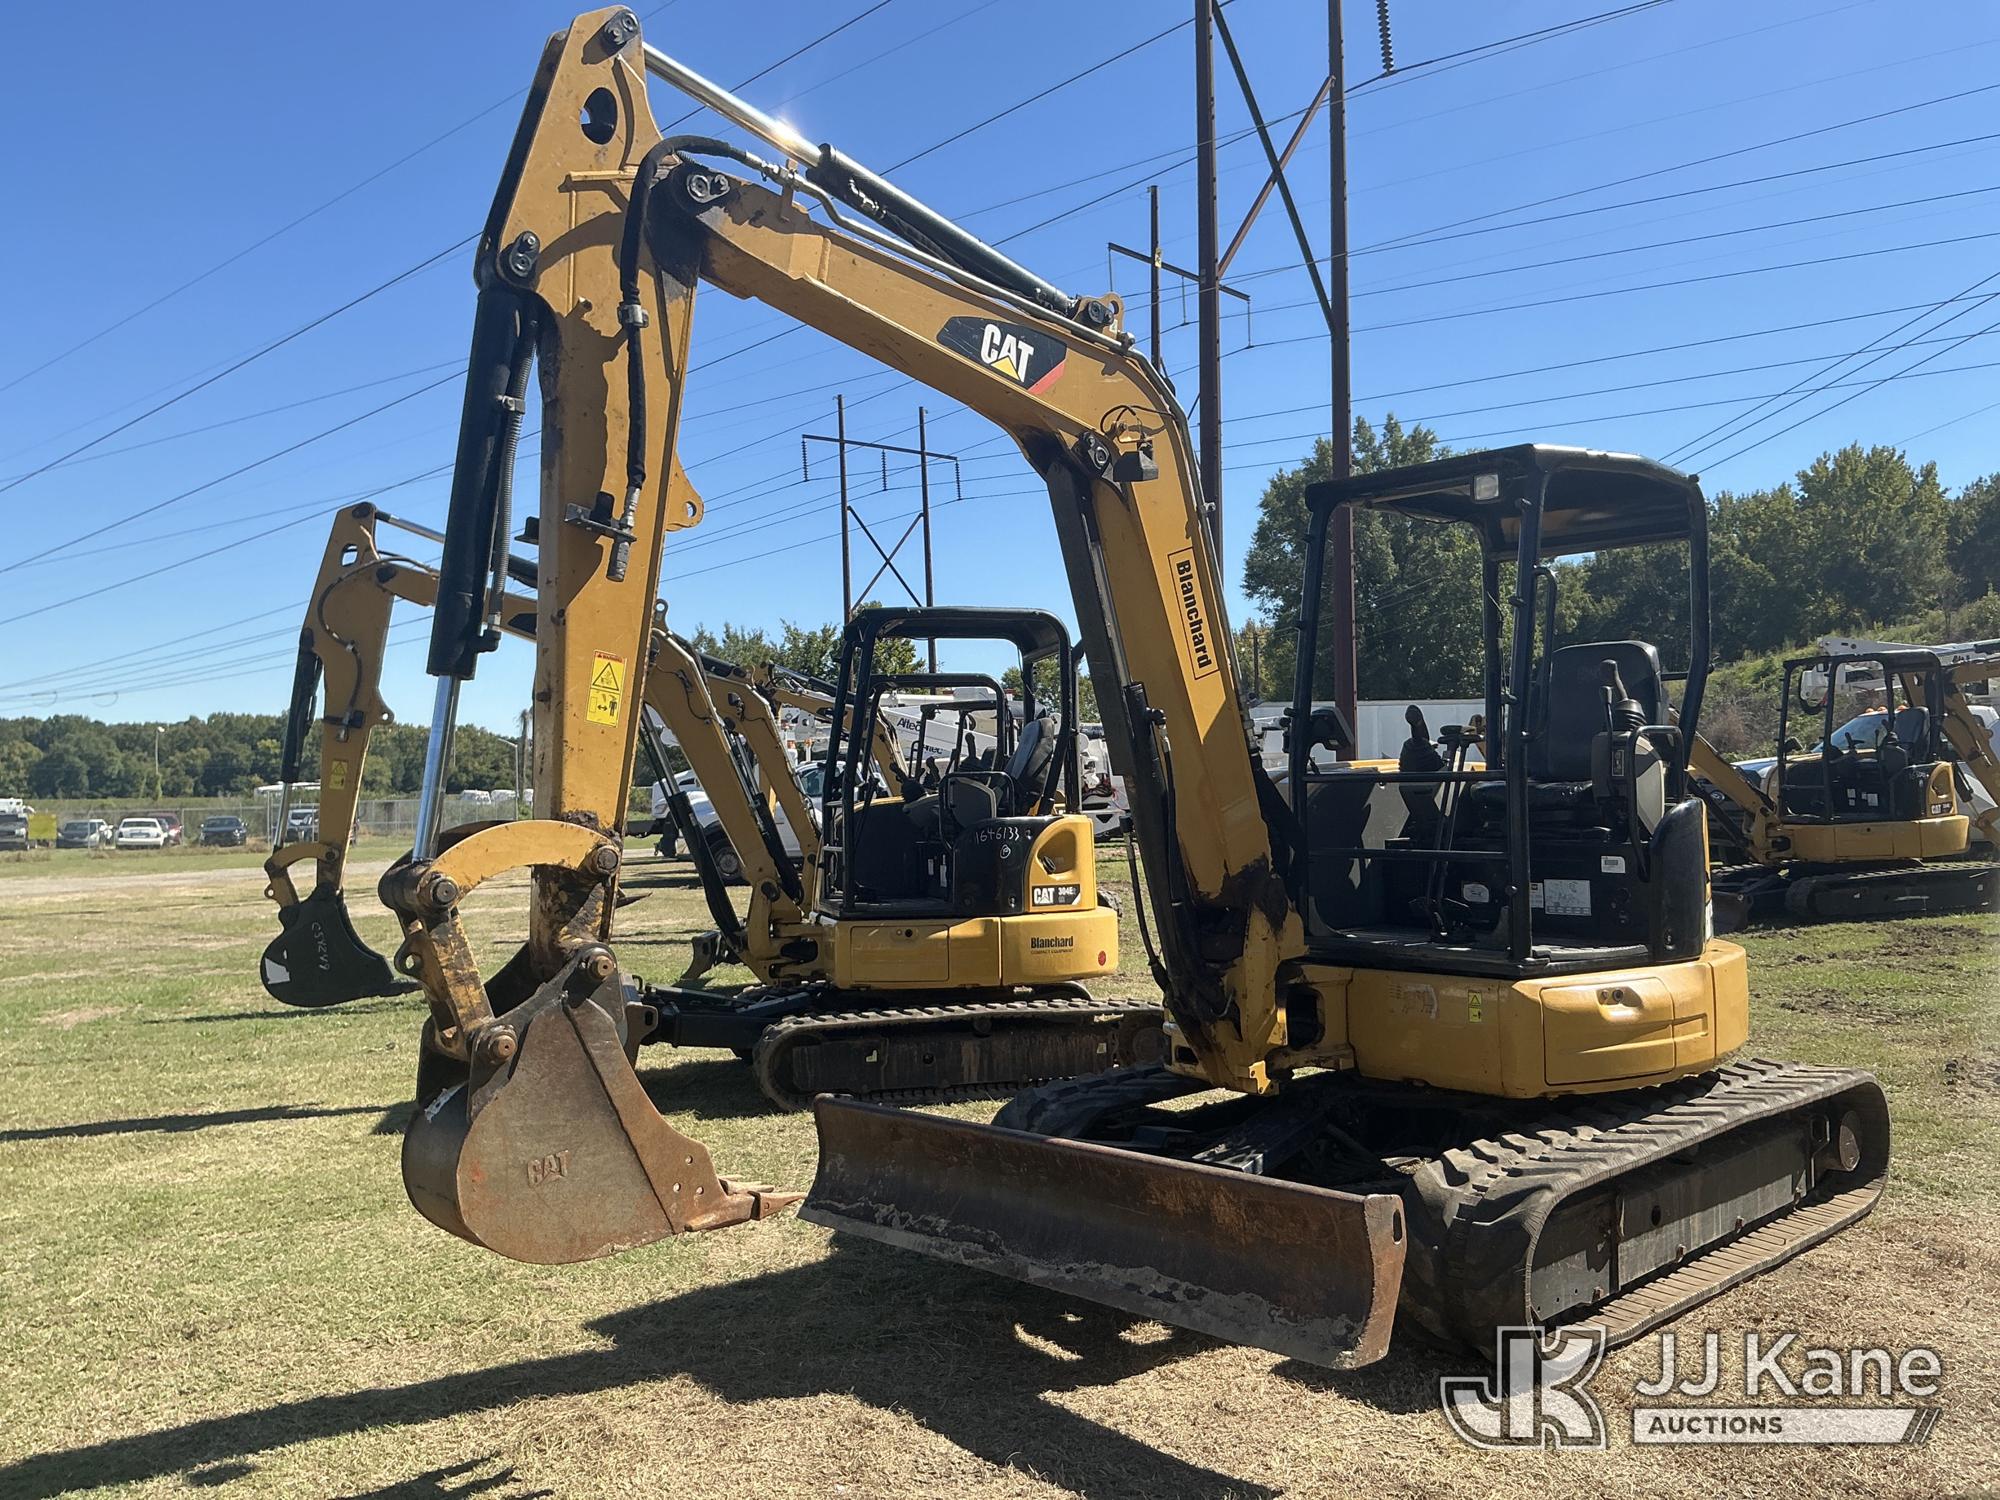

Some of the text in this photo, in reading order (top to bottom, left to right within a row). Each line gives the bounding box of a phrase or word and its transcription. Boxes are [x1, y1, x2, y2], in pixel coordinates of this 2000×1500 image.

[981, 324, 1034, 382] CAT
[1176, 560, 1212, 669] Blanchard
[975, 827, 1020, 844] 1646133
[1034, 888, 1055, 904] CAT
[1031, 936, 1073, 948] Blanchard
[528, 1150, 570, 1187] CAT
